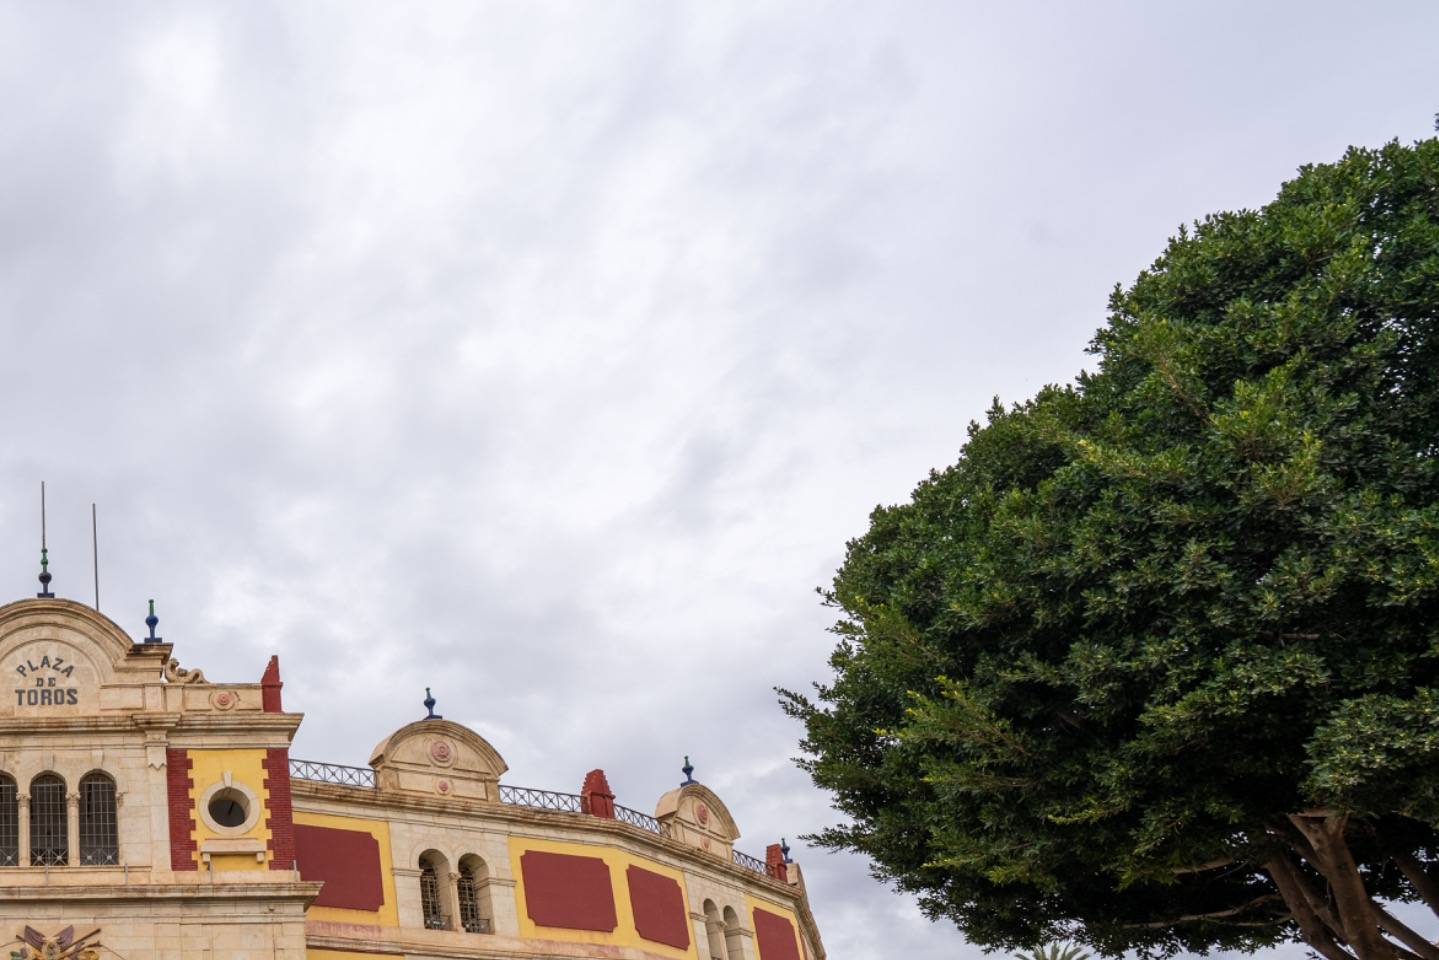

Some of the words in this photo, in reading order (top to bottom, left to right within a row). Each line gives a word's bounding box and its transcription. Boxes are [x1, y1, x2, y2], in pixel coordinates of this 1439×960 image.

[16, 655, 75, 678] PLAZA
[36, 677, 56, 687] DE
[15, 688, 78, 706] TOROS
